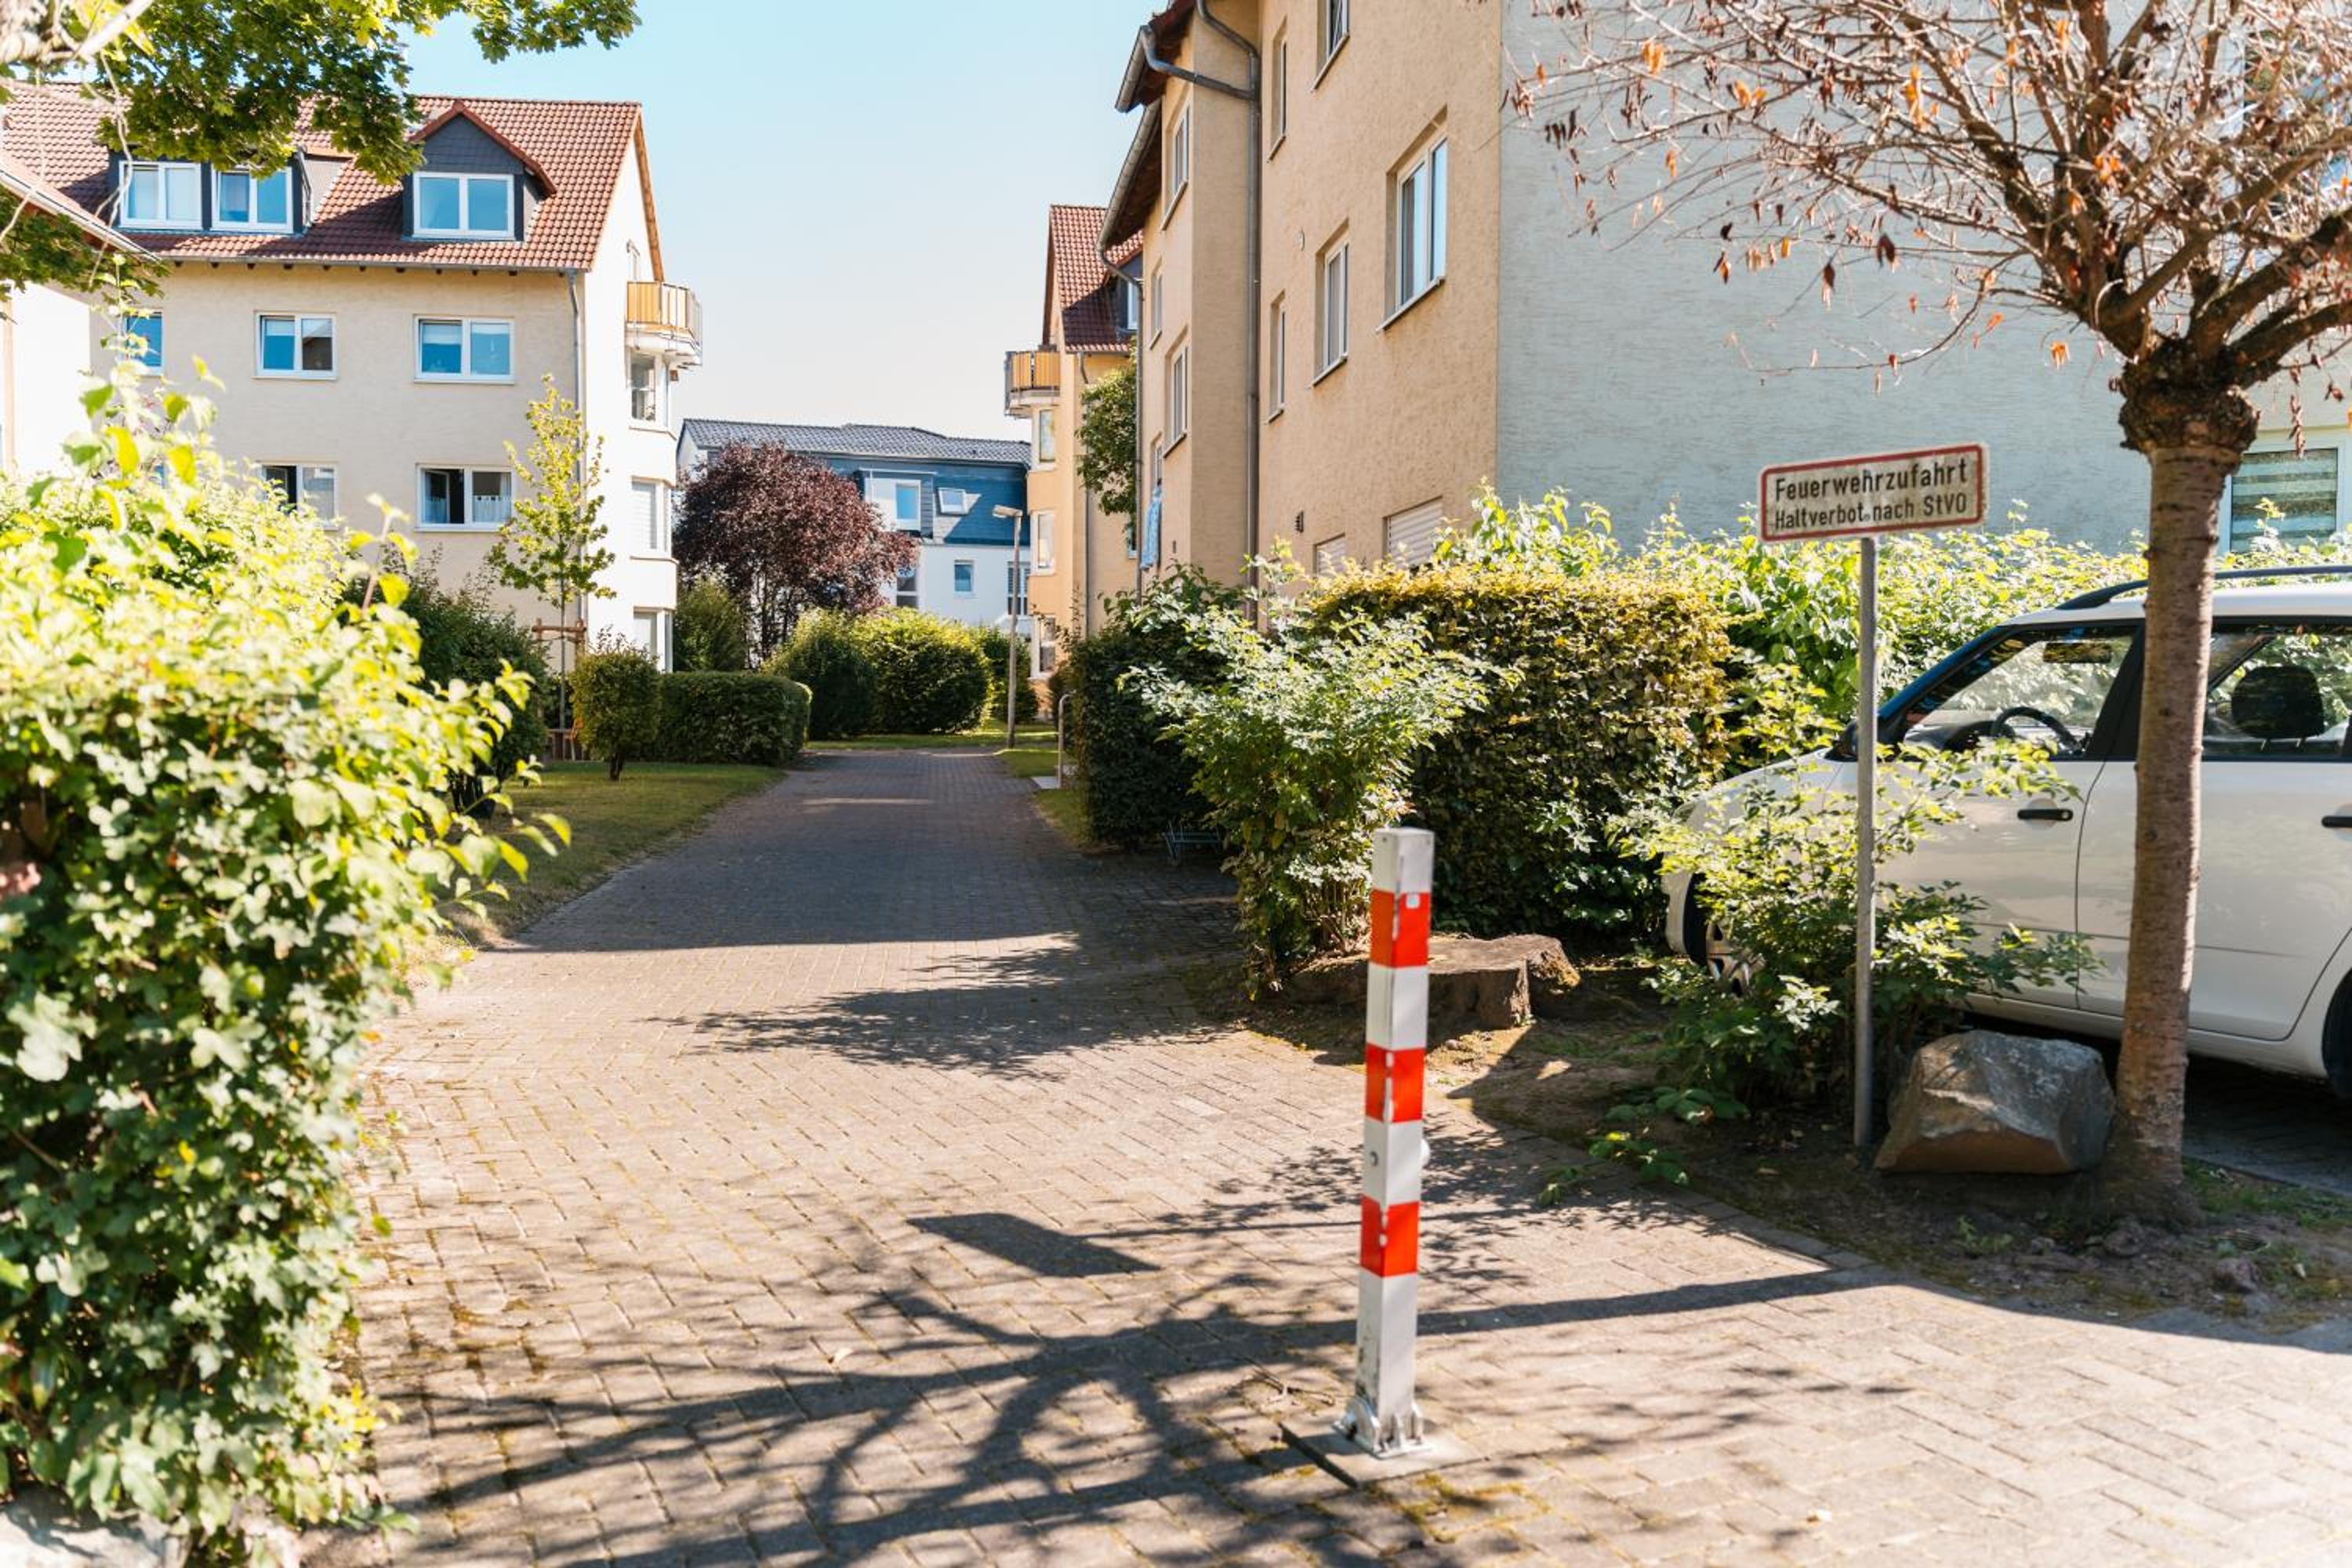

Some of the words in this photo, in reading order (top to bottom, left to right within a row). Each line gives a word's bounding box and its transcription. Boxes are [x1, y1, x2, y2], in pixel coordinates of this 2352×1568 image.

[1775, 458, 1967, 502] Feuerwehrzufahrt
[1774, 501, 1864, 530] Haltverbot
[1872, 498, 1914, 521] nach
[1923, 492, 1967, 516] StVO
